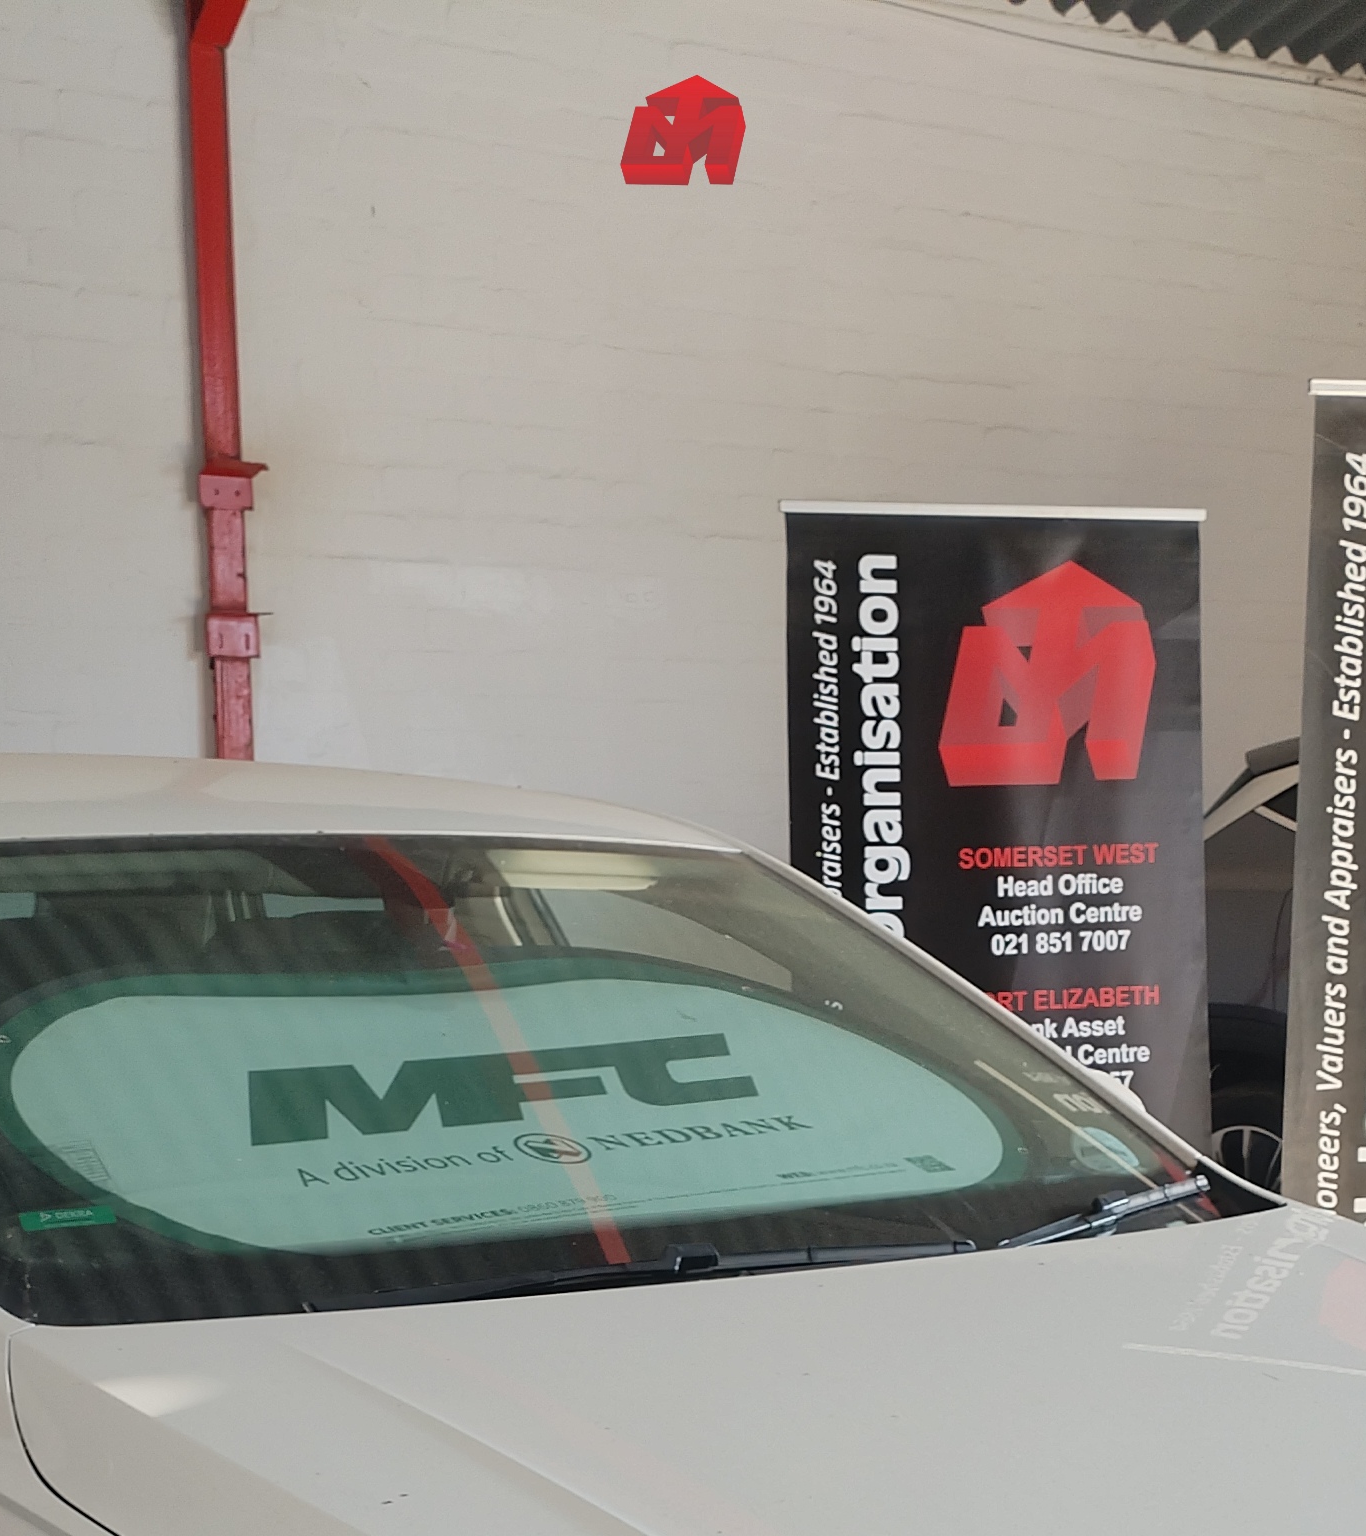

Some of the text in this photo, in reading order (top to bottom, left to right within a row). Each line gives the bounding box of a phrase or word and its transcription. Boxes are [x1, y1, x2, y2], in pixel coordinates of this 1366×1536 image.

[813, 559, 838, 625] 1964
[812, 630, 840, 781] Established
[1324, 747, 1360, 911] Appraisers
[958, 842, 1159, 870] SOMERSET WEST
[997, 873, 1124, 898] Head Office
[977, 901, 1143, 927] Auction Centre
[990, 929, 1132, 956] 021 851 7007
[1322, 914, 1351, 974] and
[985, 984, 1161, 1012] RT ELIZABETH
[1031, 1015, 1126, 1039] nk Asset
[1316, 980, 1348, 1093] Valuers
[1077, 1043, 1151, 1066] Centre
[248, 1033, 760, 1146] MFC
[296, 1167, 330, 1188] A
[334, 1147, 473, 1183] division
[476, 1145, 514, 1167] of
[587, 1113, 814, 1152] NEDBANK
[1316, 1101, 1347, 1215] oneers,
[367, 1219, 431, 1237] CLIENT
